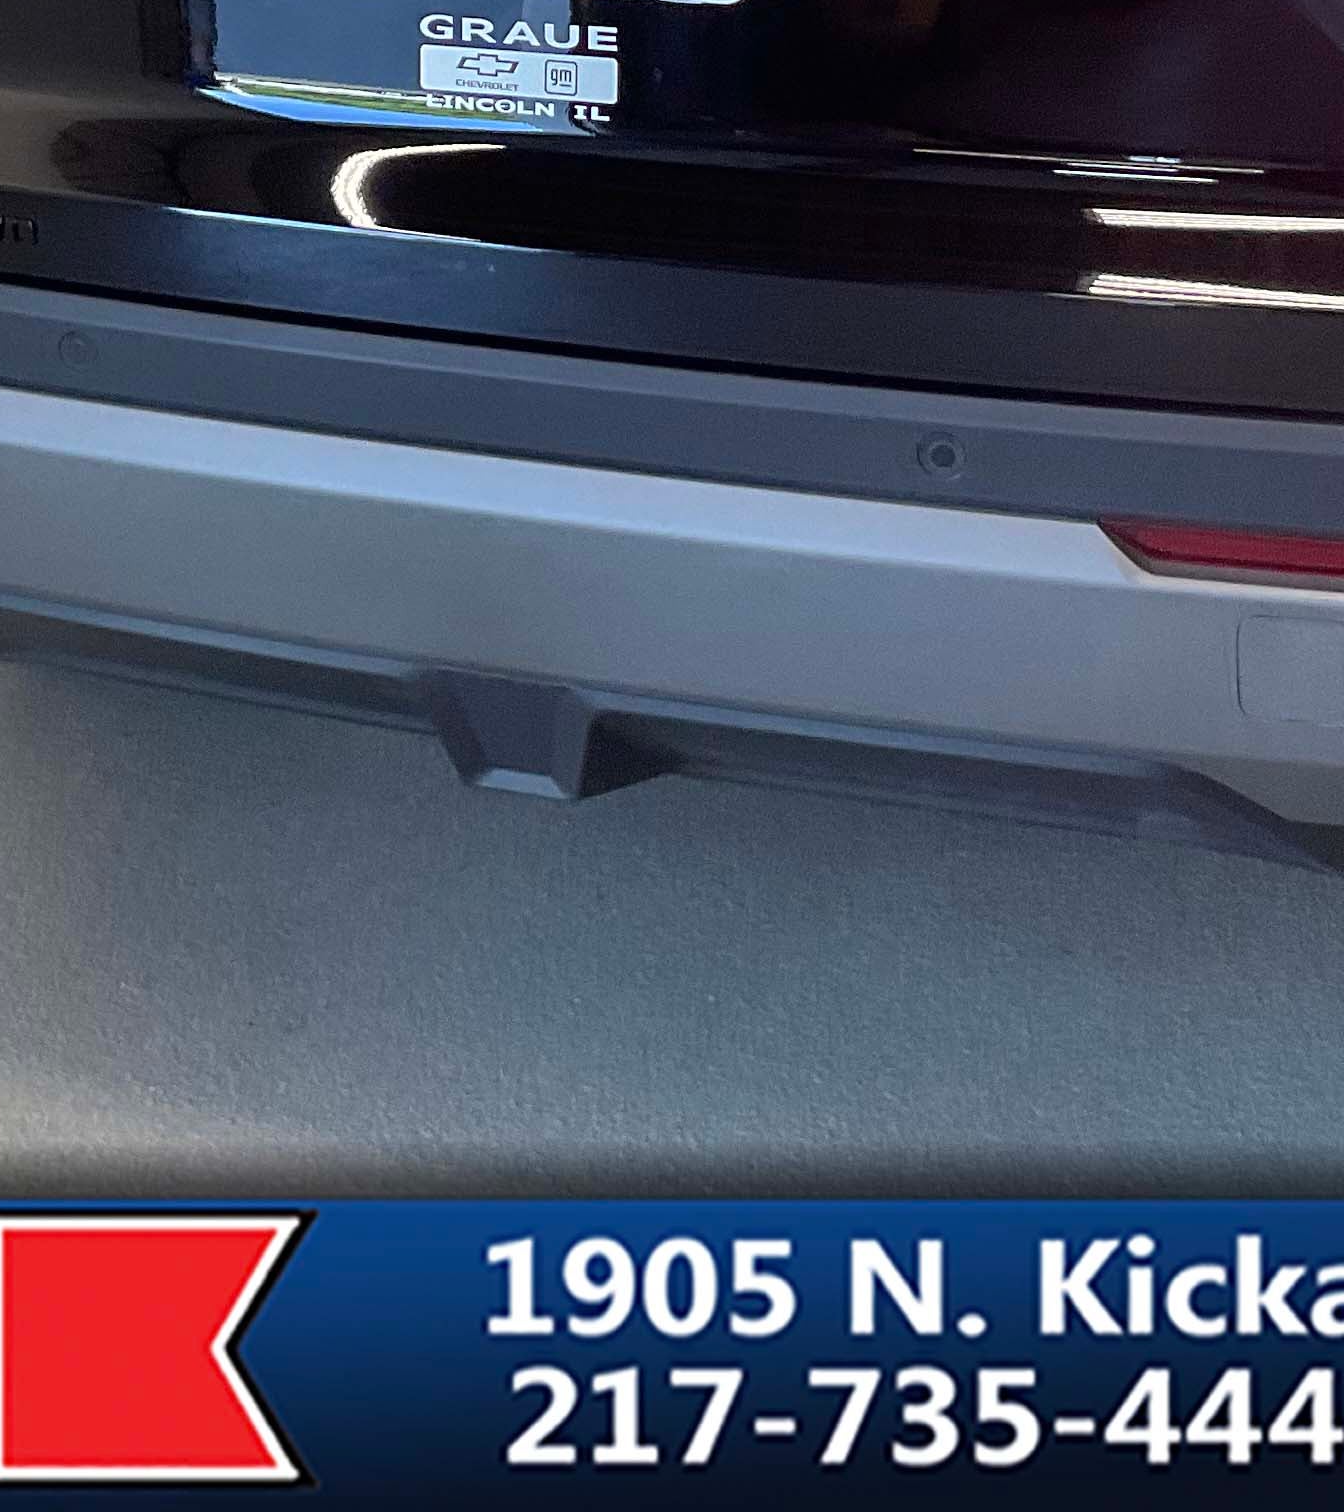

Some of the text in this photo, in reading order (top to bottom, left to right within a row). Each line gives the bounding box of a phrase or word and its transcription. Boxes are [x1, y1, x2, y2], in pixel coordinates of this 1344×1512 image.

[419, 13, 618, 53] GRAUE
[456, 79, 519, 92] CHEVROLET
[426, 93, 611, 122] LINCOLN IL
